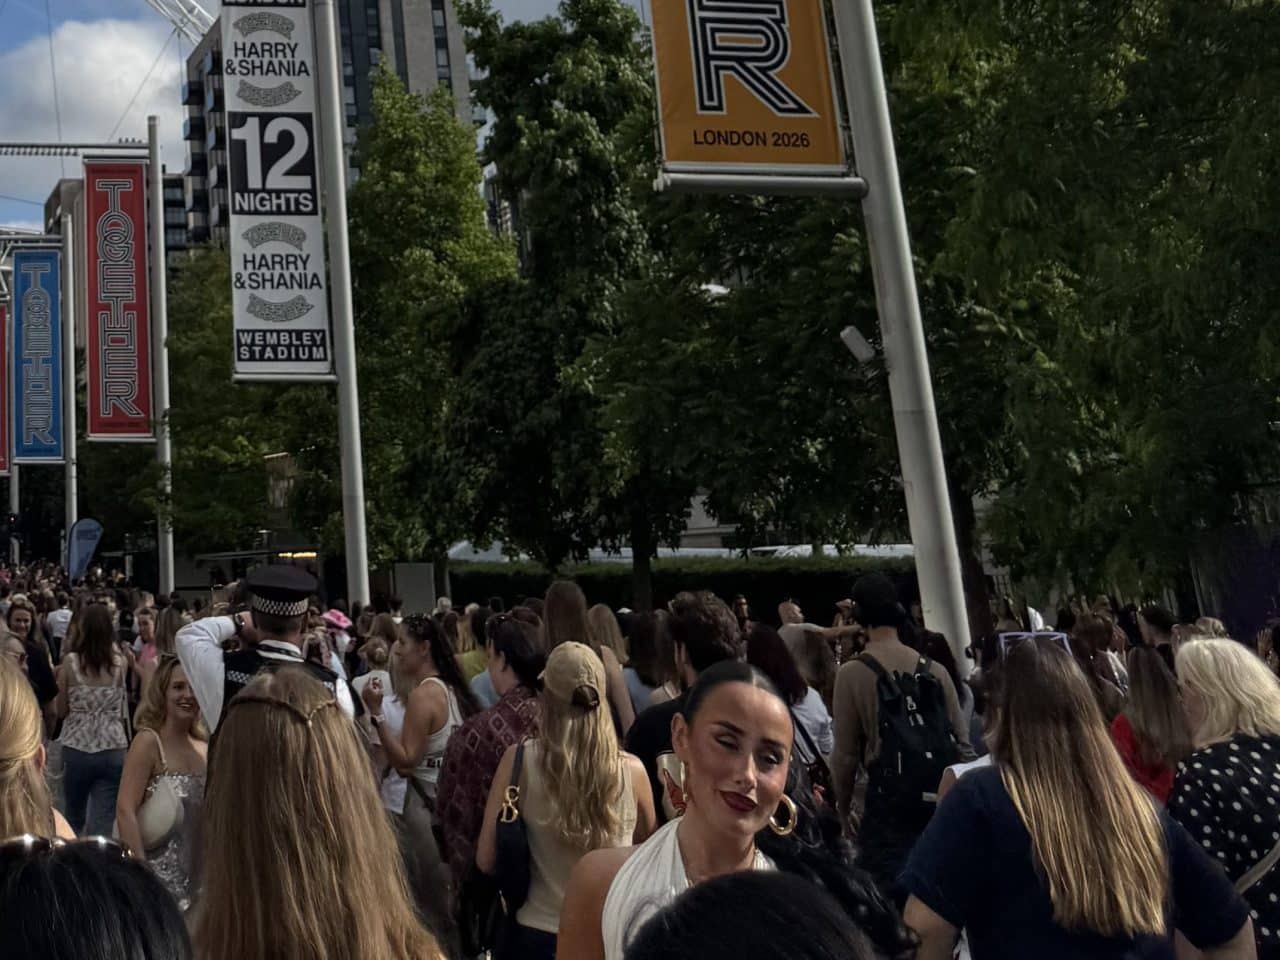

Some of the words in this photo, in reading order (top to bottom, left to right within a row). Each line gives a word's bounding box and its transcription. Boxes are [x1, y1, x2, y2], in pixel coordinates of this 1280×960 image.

[233, 41, 298, 58] HARRY
[693, 129, 767, 147] LONDON
[771, 130, 810, 148] 2026
[231, 116, 312, 190] 12
[234, 192, 313, 212] NIGHTS
[243, 253, 311, 270] HARRY
[95, 178, 145, 417] TOGETHER
[238, 331, 323, 345] WEMBLEY
[20, 262, 57, 445] TOGETHER
[239, 346, 325, 359] STADIUM
